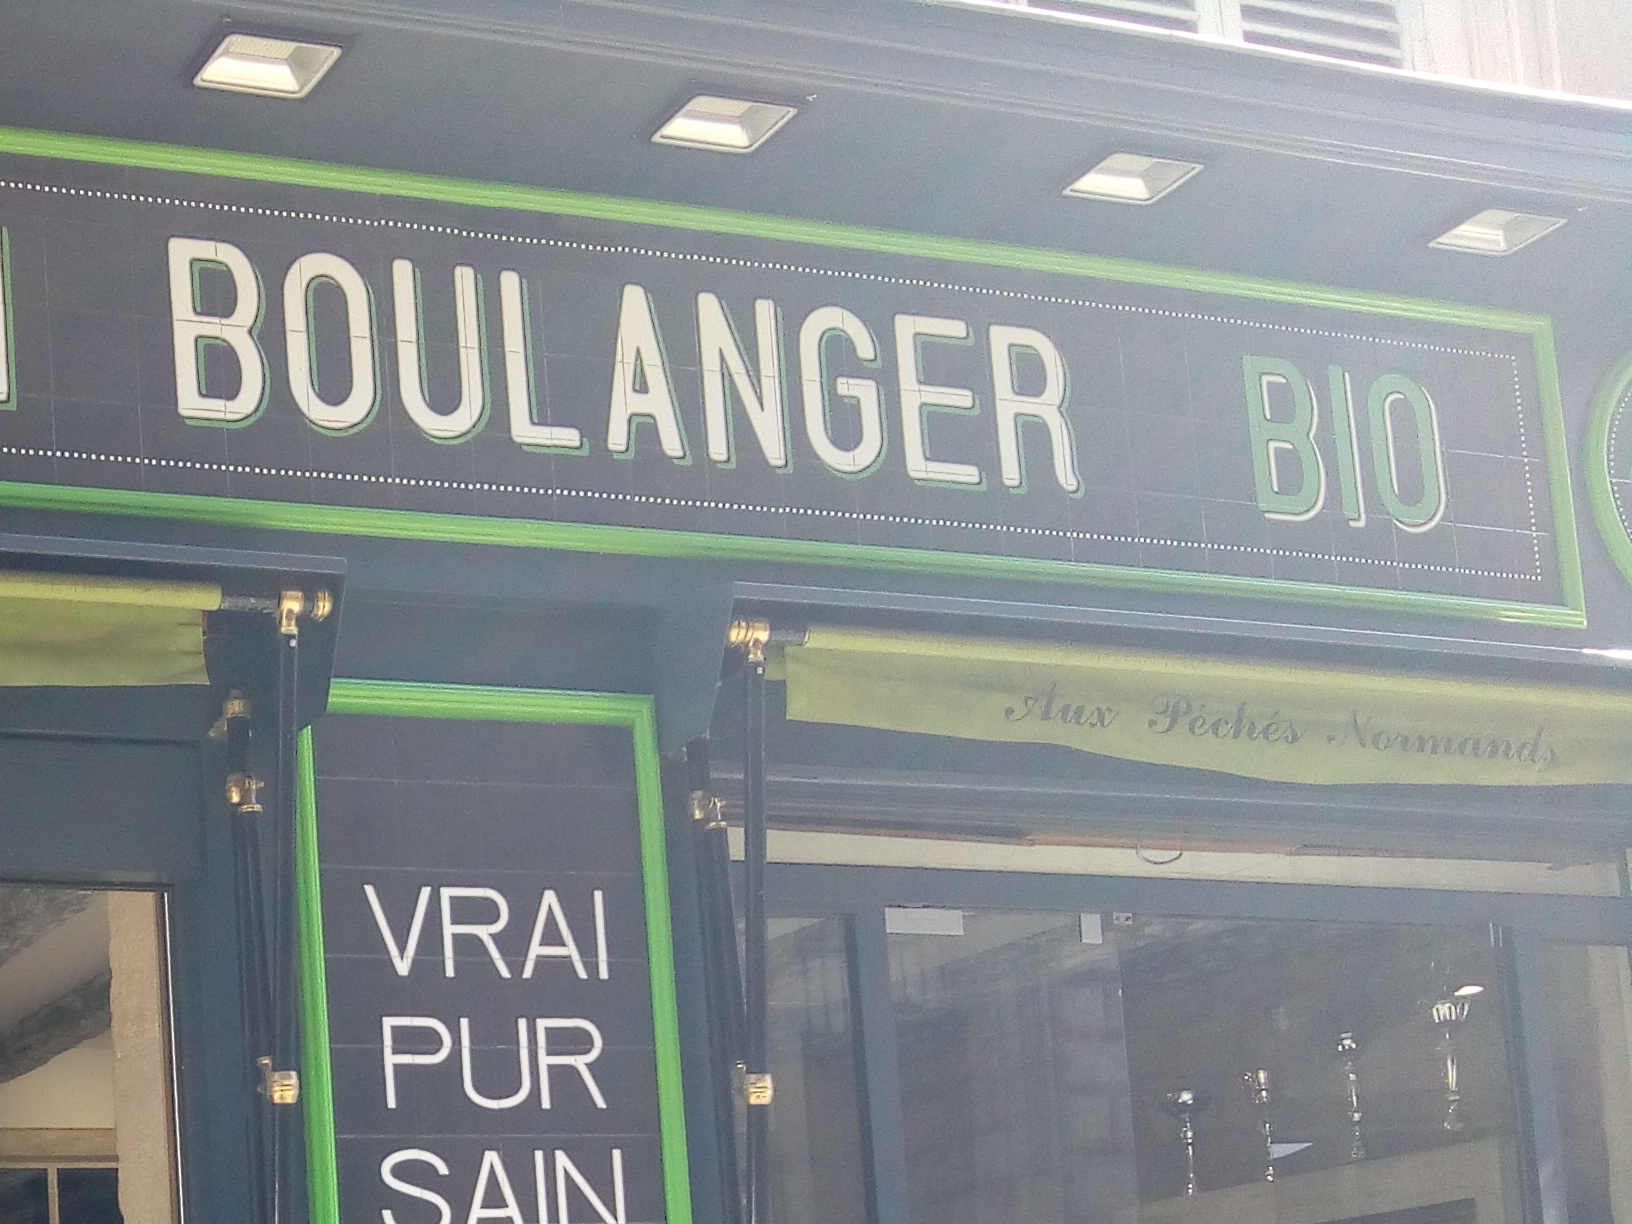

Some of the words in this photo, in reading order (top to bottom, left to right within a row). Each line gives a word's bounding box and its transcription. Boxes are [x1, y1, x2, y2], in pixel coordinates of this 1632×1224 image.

[167, 236, 1082, 495] BOULANGER
[1242, 355, 1447, 533] BIO
[1004, 681, 1118, 729] Aux
[1147, 693, 1308, 746] Péchés
[1326, 709, 1564, 774] Normands
[363, 884, 610, 980] VRAI
[382, 1016, 608, 1110] PUR
